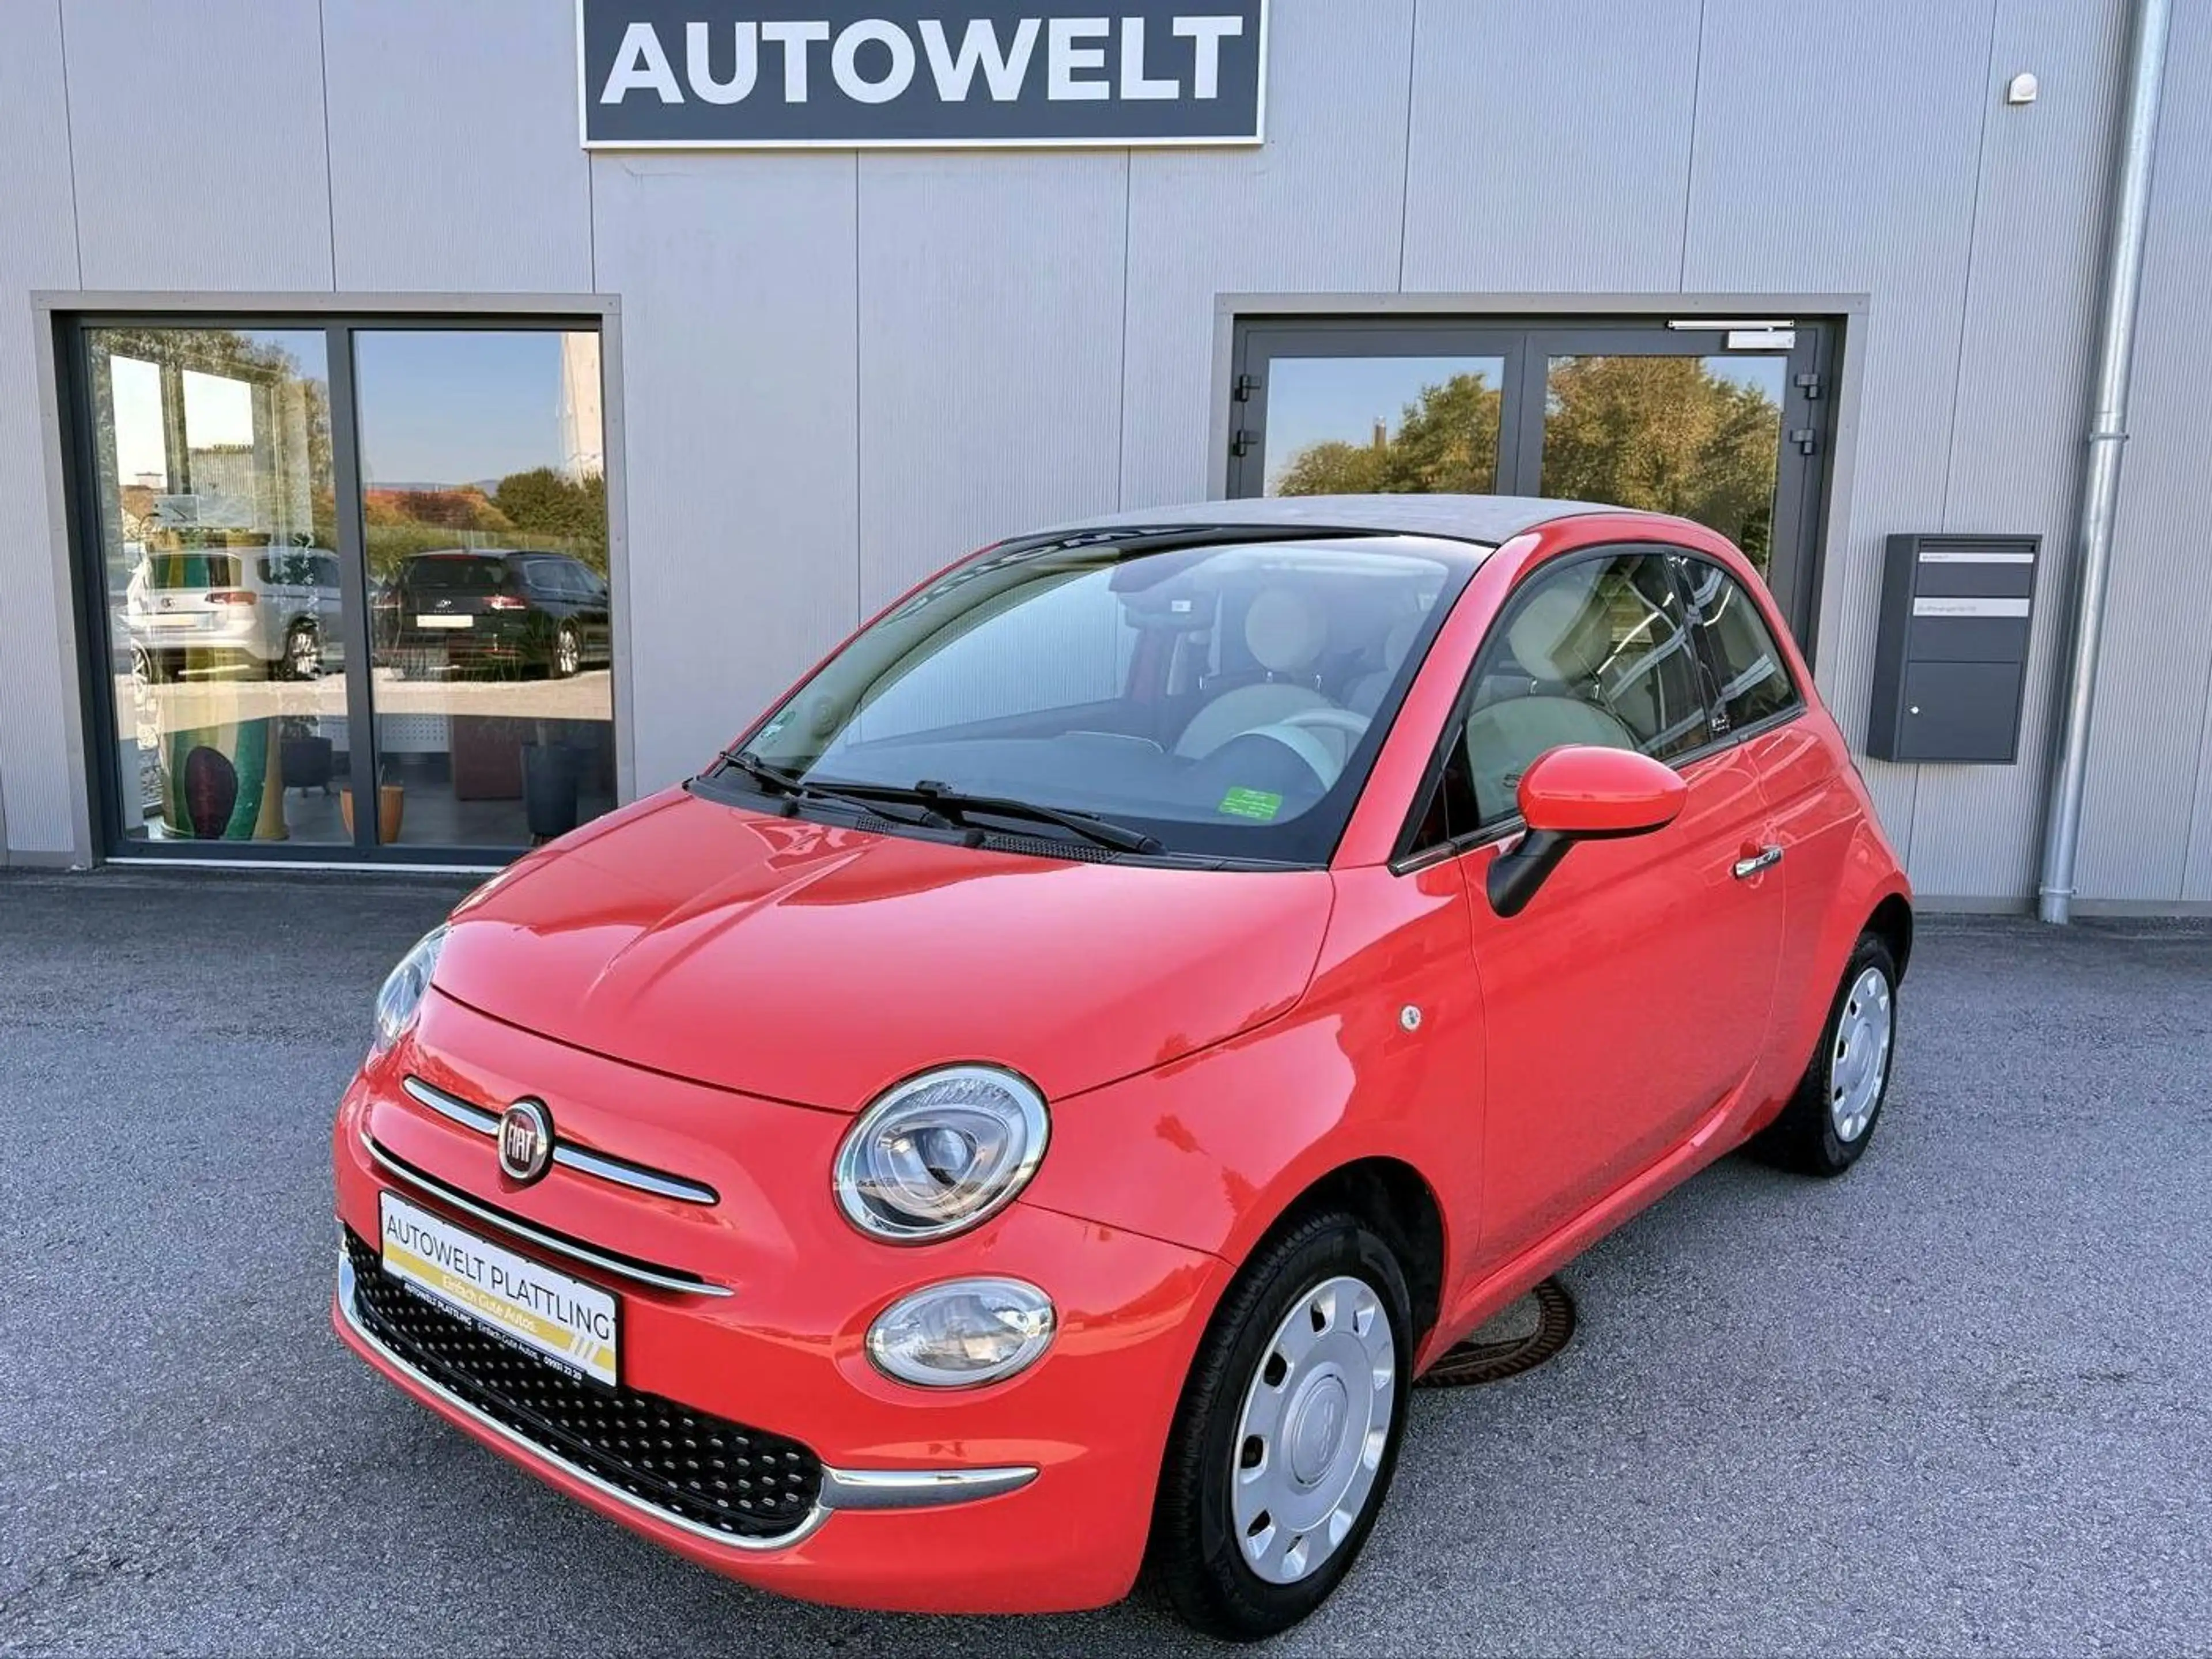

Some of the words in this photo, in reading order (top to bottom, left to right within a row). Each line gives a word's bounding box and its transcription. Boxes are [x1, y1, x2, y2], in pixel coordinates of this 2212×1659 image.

[600, 16, 1243, 105] AUTOWELT
[507, 1122, 535, 1162] FIAT
[387, 1214, 485, 1283] AUTOWELT
[491, 1265, 609, 1340] PLATTLING
